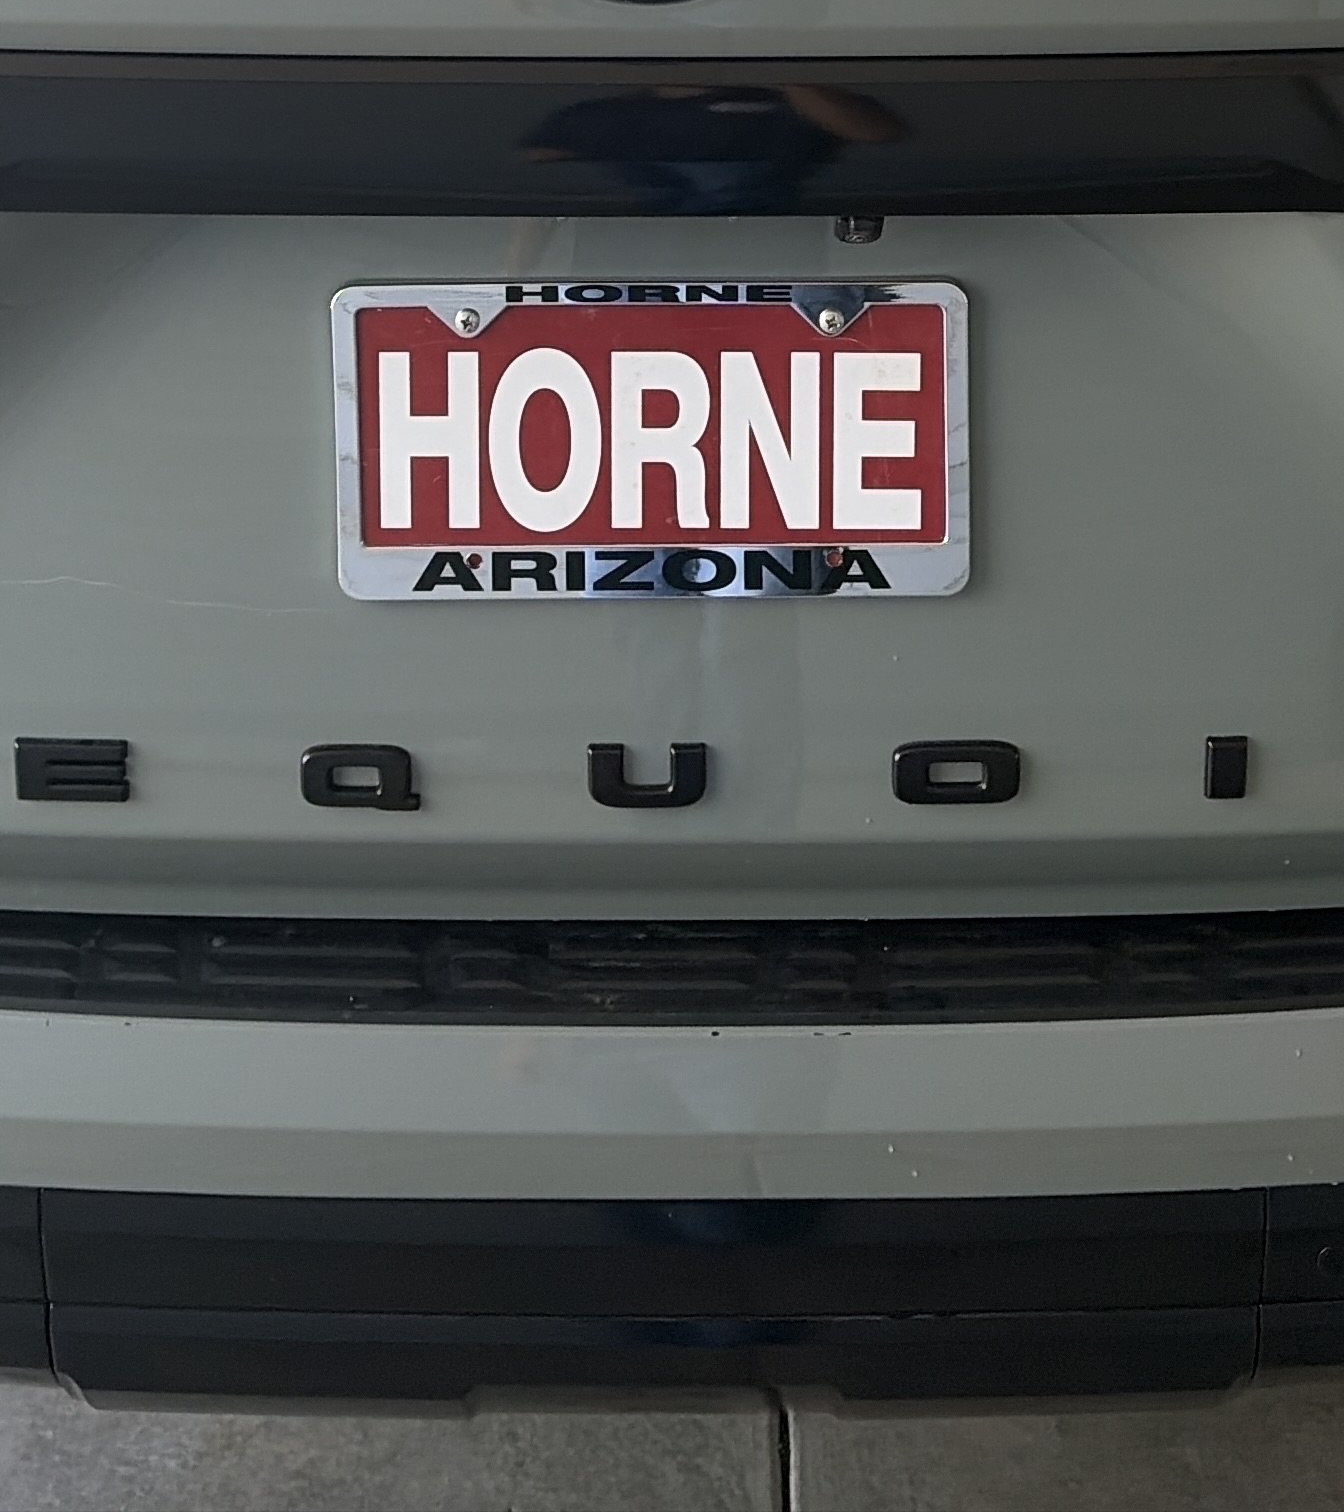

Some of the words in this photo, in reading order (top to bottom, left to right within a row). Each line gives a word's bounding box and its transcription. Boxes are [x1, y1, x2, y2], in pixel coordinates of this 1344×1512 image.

[505, 284, 793, 303] HORNE
[378, 347, 923, 533] HORNE
[412, 550, 892, 593] ARIZONA
